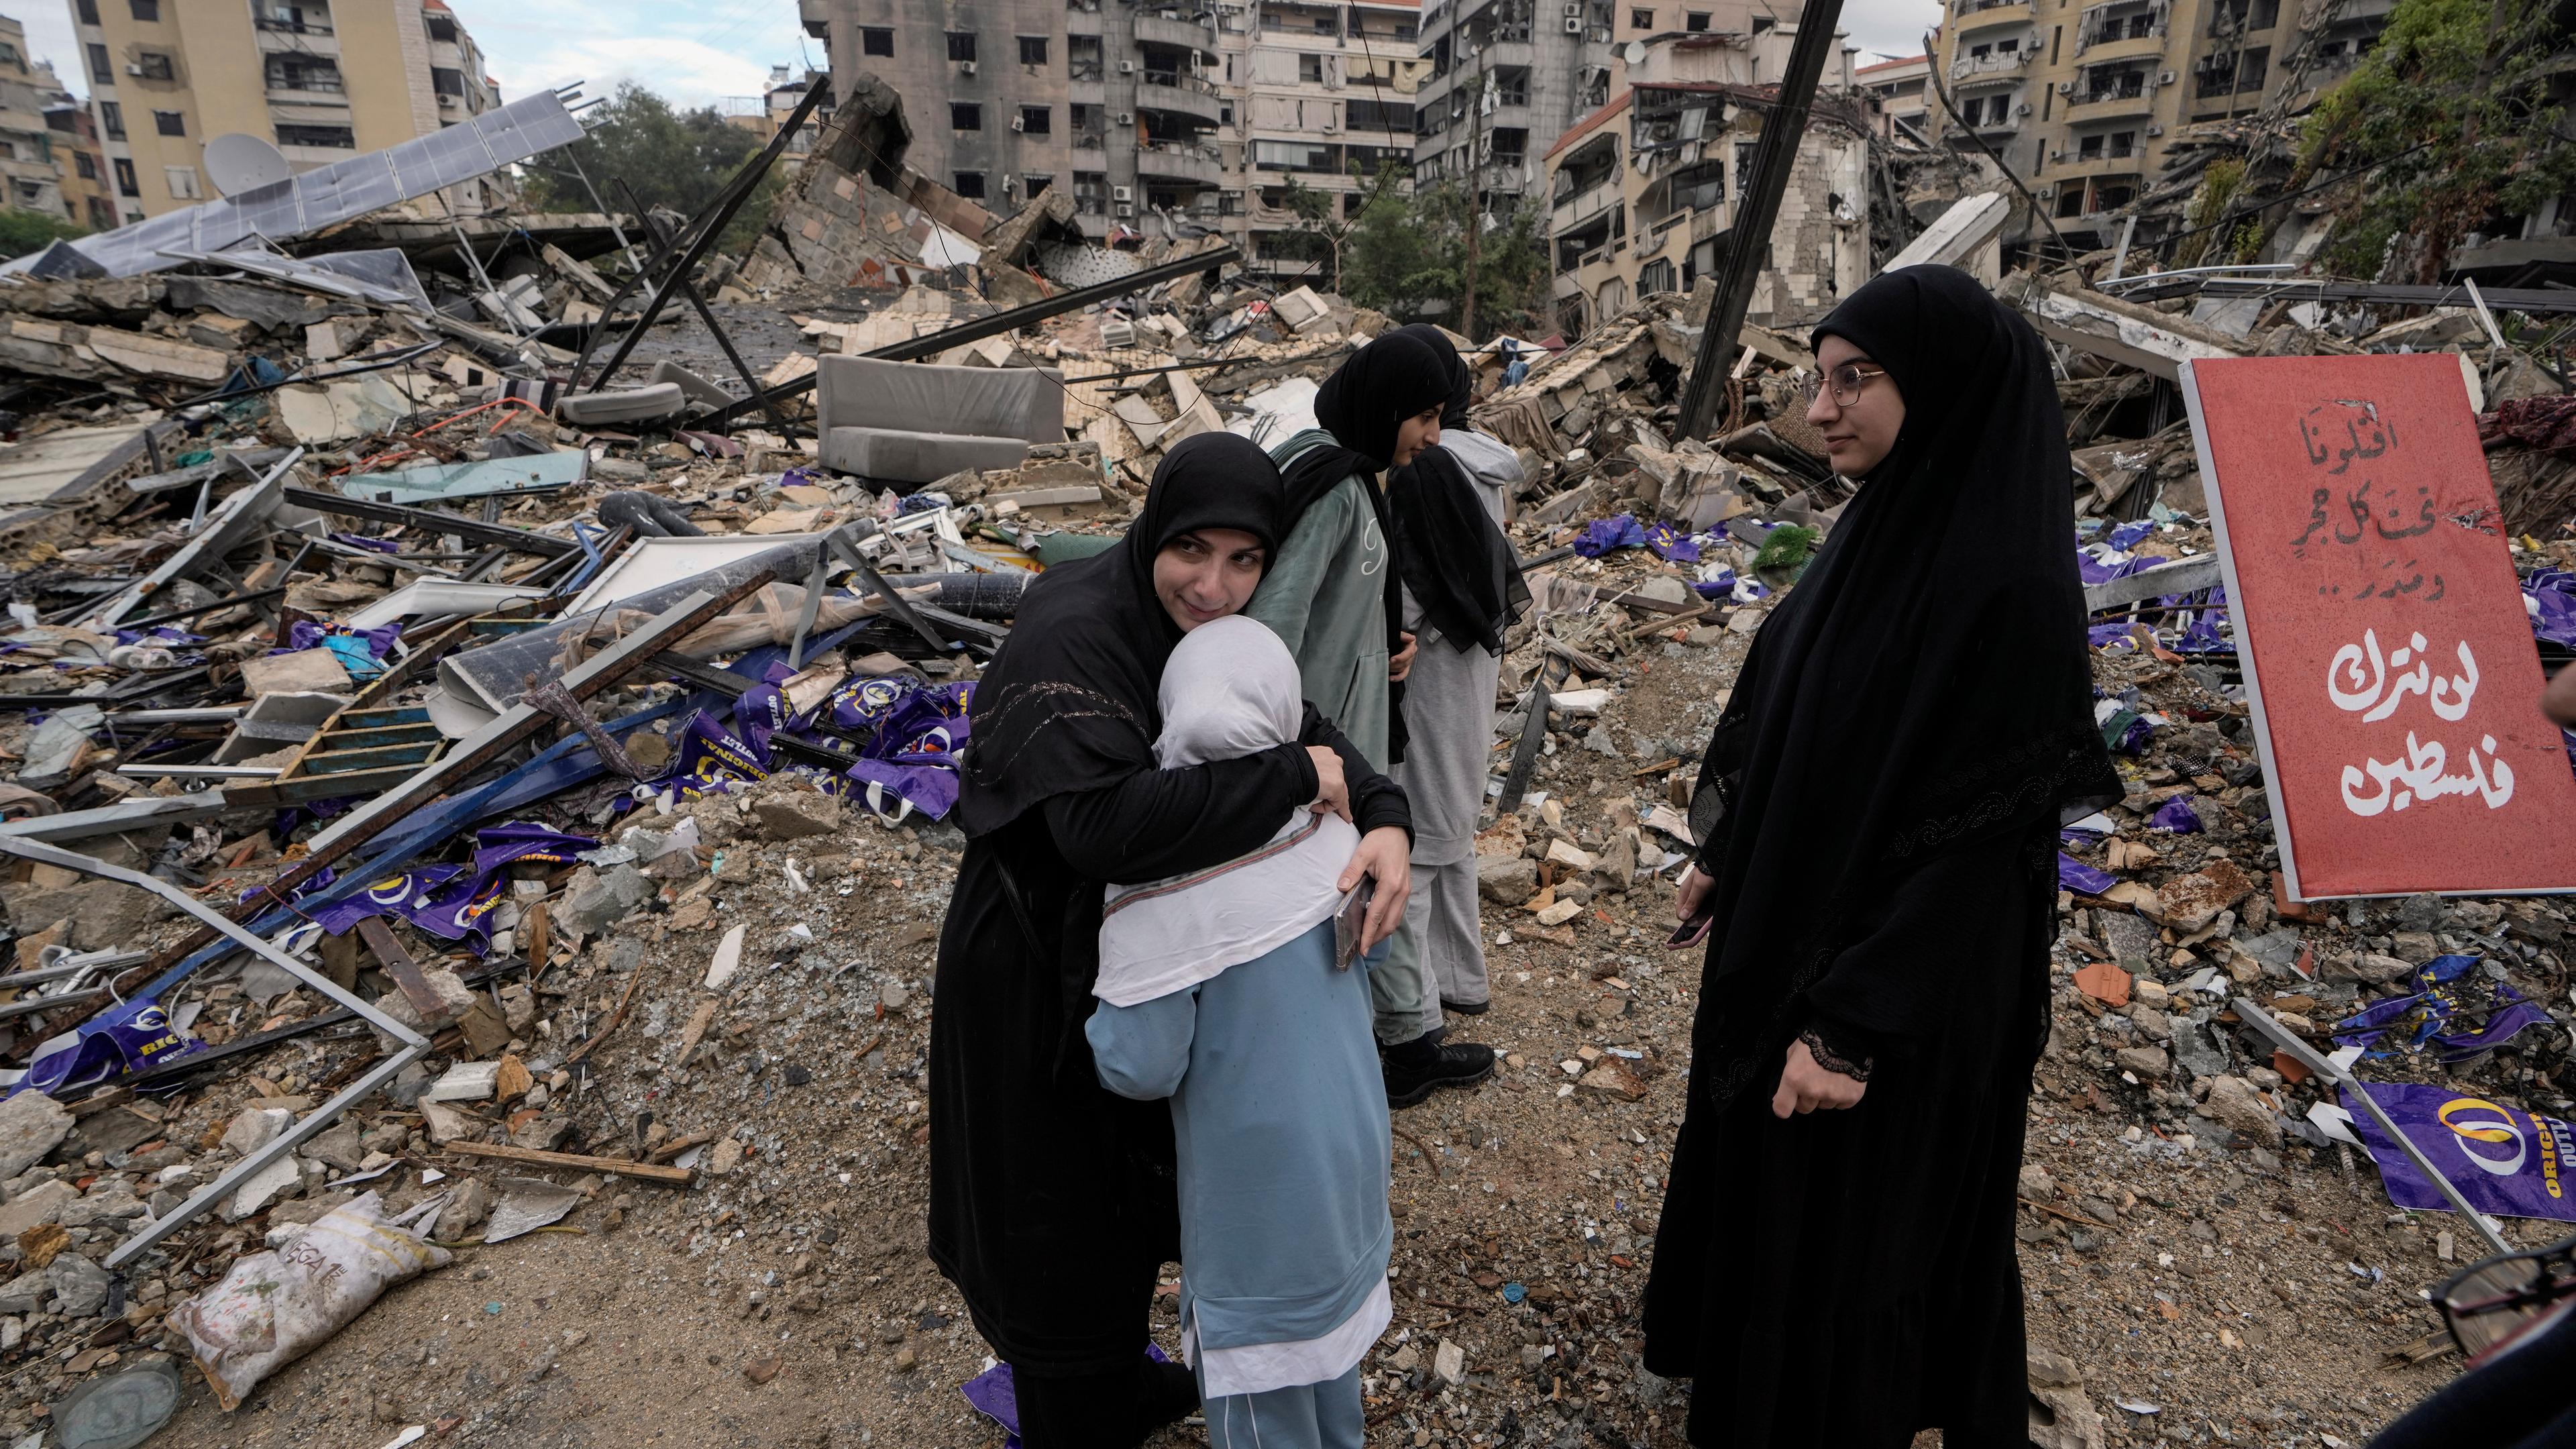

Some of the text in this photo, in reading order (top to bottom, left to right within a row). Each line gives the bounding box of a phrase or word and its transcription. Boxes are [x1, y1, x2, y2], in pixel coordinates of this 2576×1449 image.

[2328, 628, 2479, 723] لن نترك
[2341, 730, 2514, 816] فلسطين
